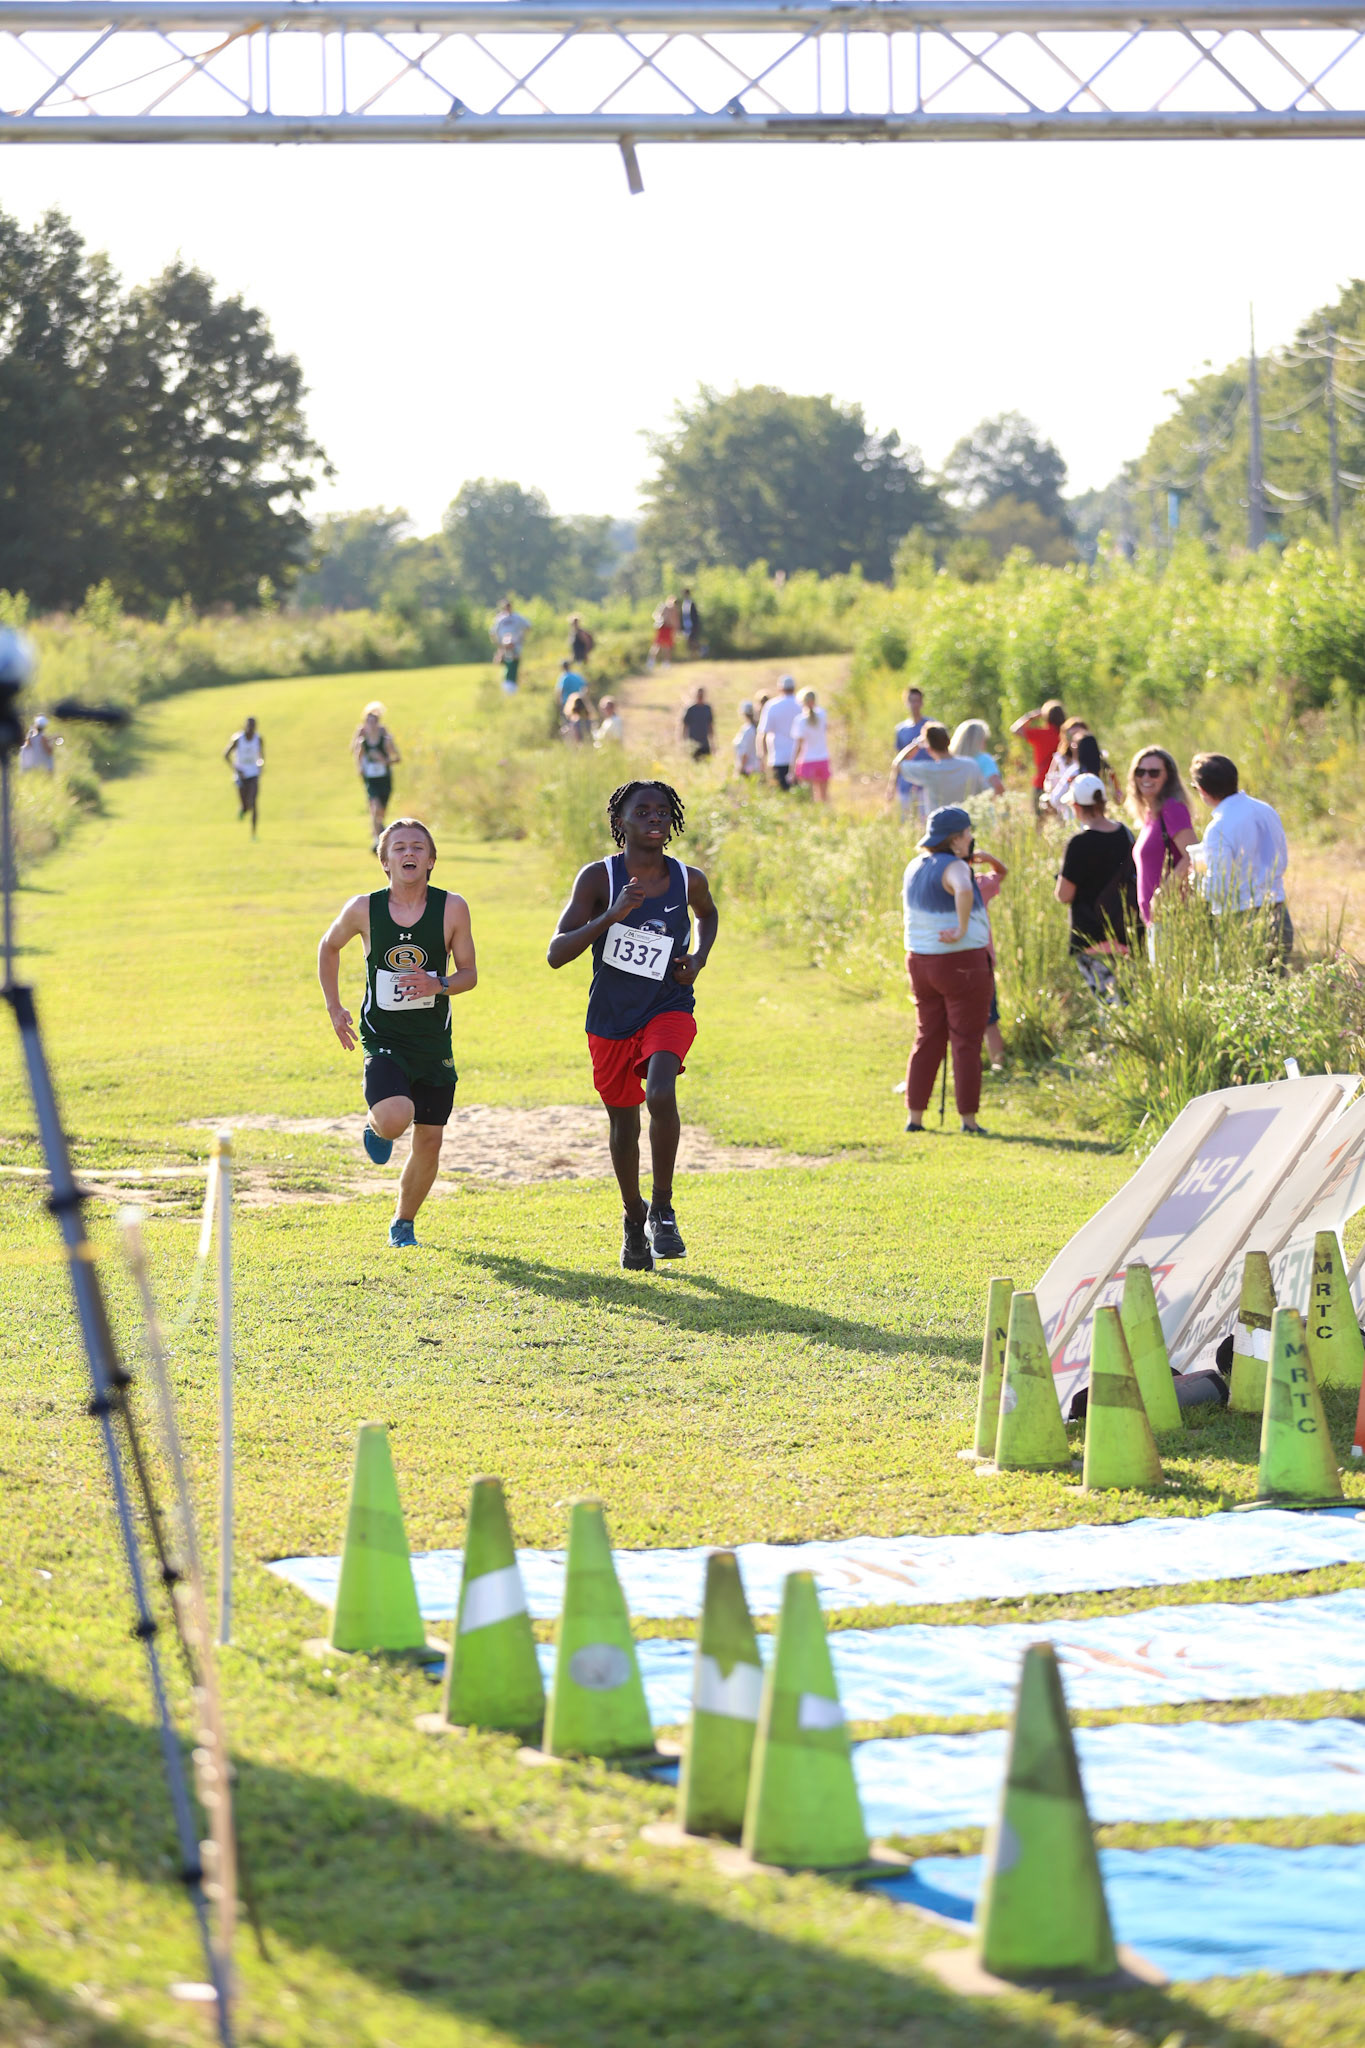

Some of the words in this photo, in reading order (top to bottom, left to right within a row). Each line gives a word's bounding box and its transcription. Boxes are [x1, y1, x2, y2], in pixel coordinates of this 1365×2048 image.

[613, 938, 663, 969] 1337
[1313, 1261, 1334, 1339] MRTC
[1285, 1343, 1317, 1433] MRTC
